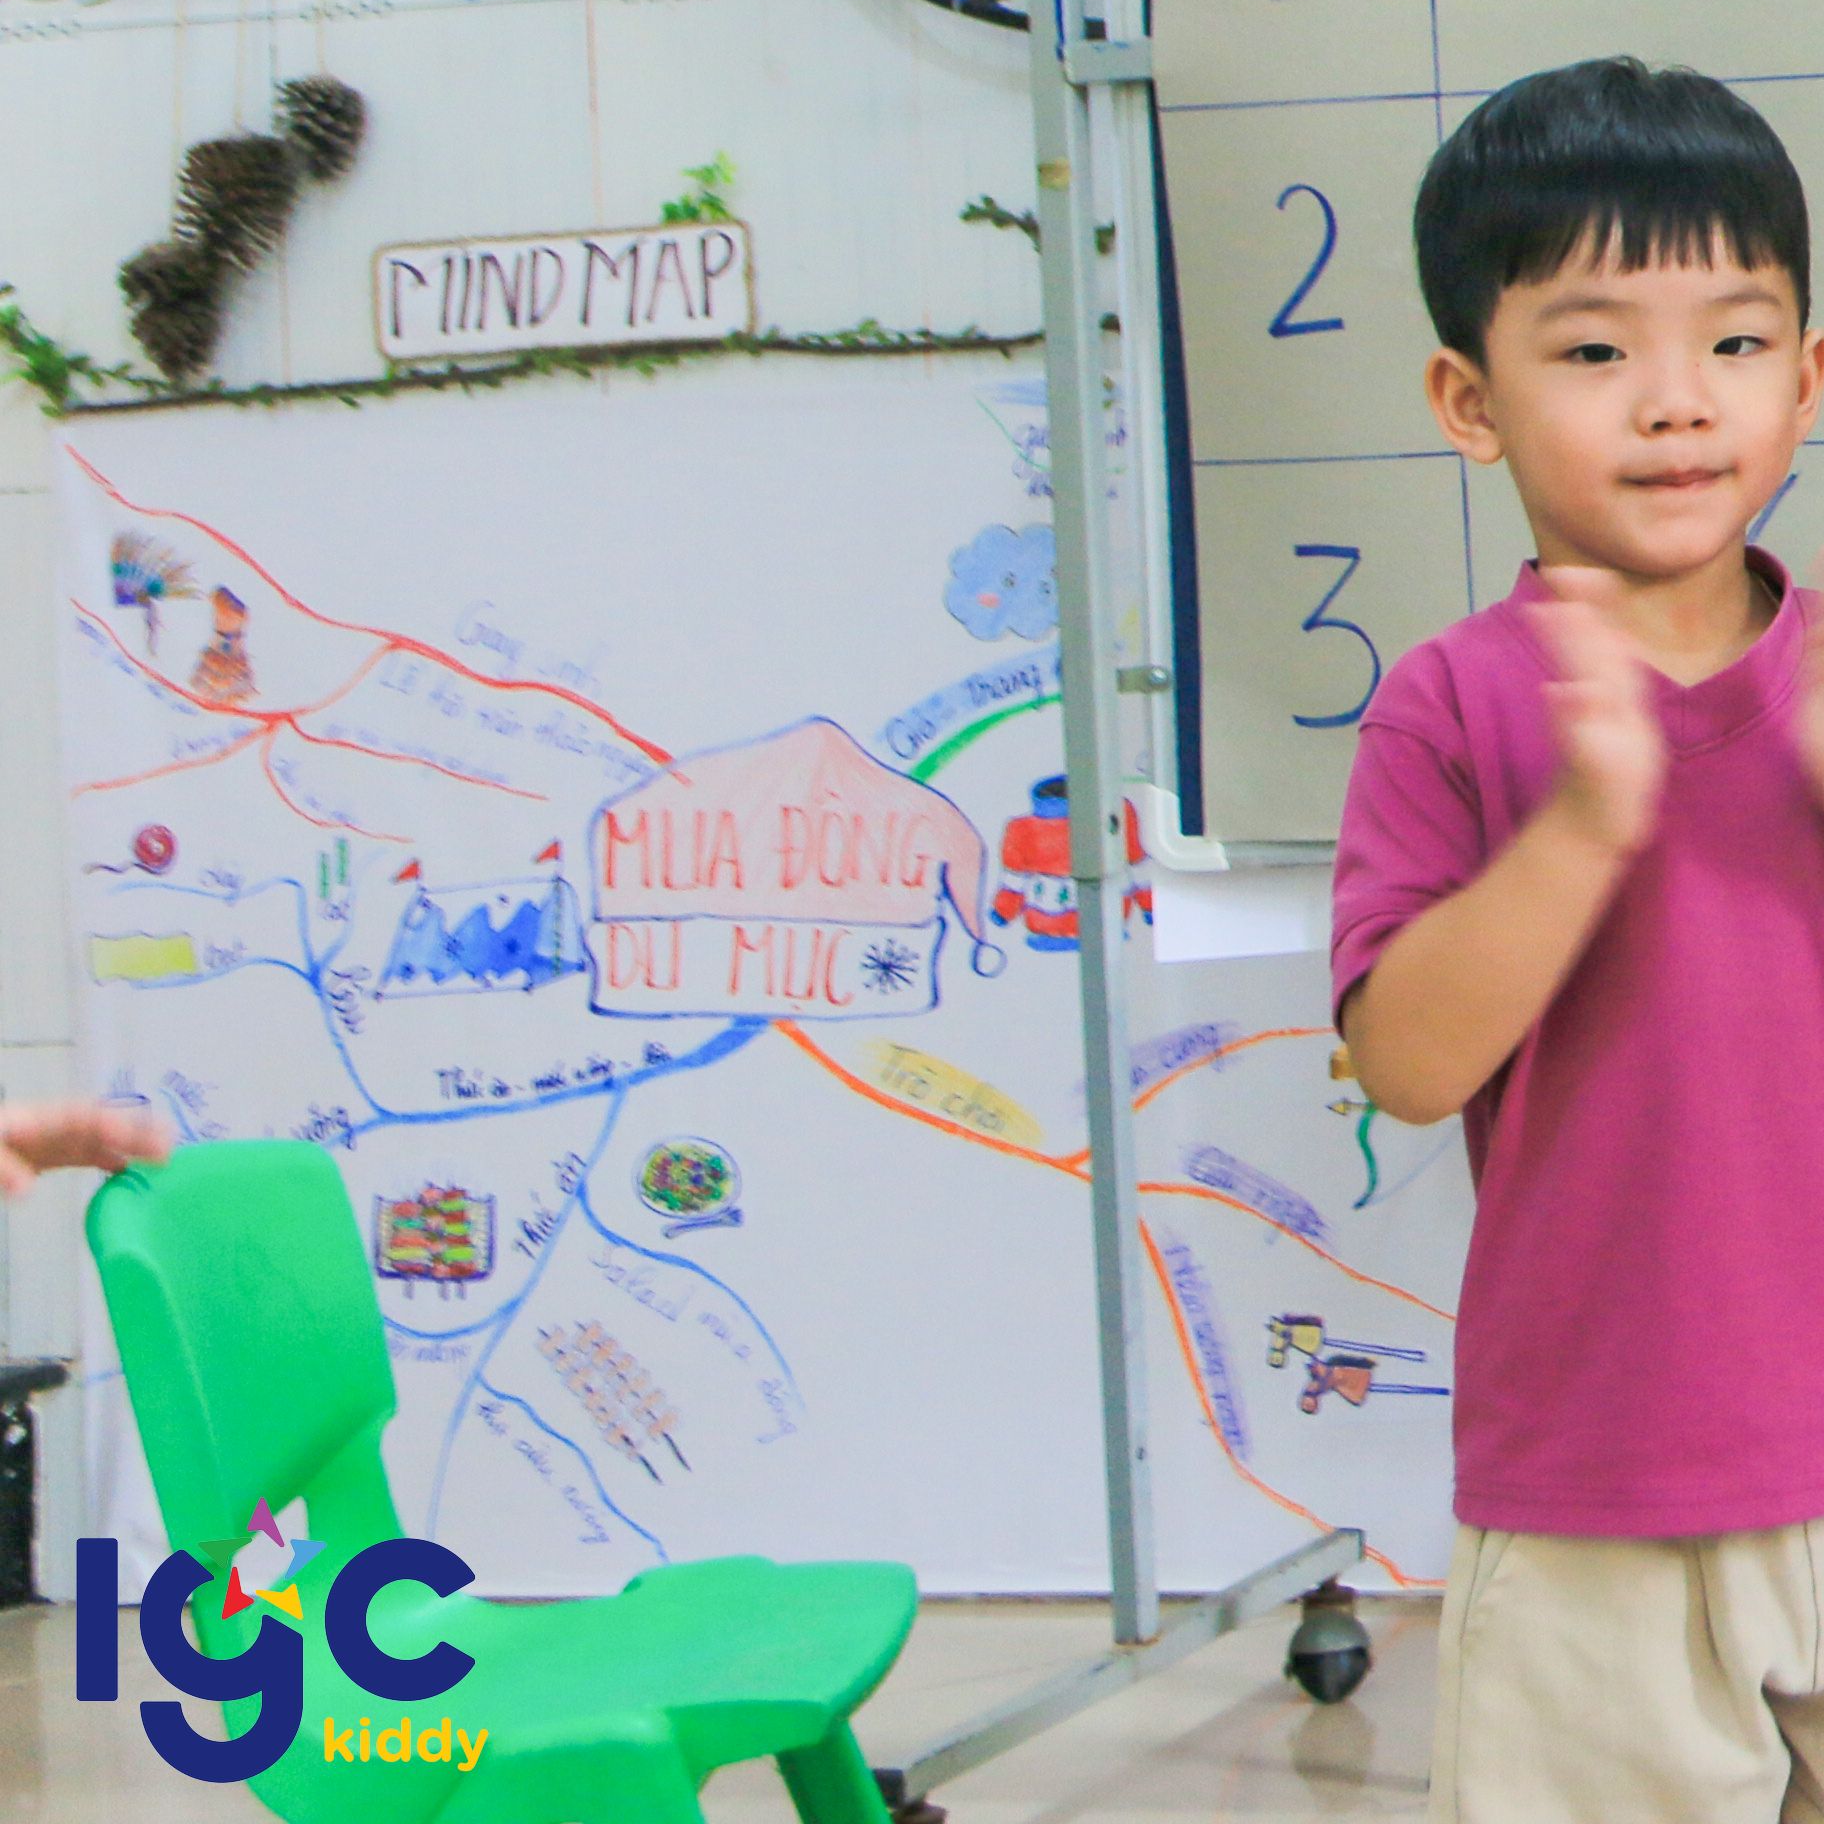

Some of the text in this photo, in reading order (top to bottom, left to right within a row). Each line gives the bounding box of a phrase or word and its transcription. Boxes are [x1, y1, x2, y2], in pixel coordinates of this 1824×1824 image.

[388, 227, 736, 339] MIND MAP
[1269, 183, 1345, 339] 2
[1292, 543, 1381, 728] 3
[609, 922, 681, 990] DU
